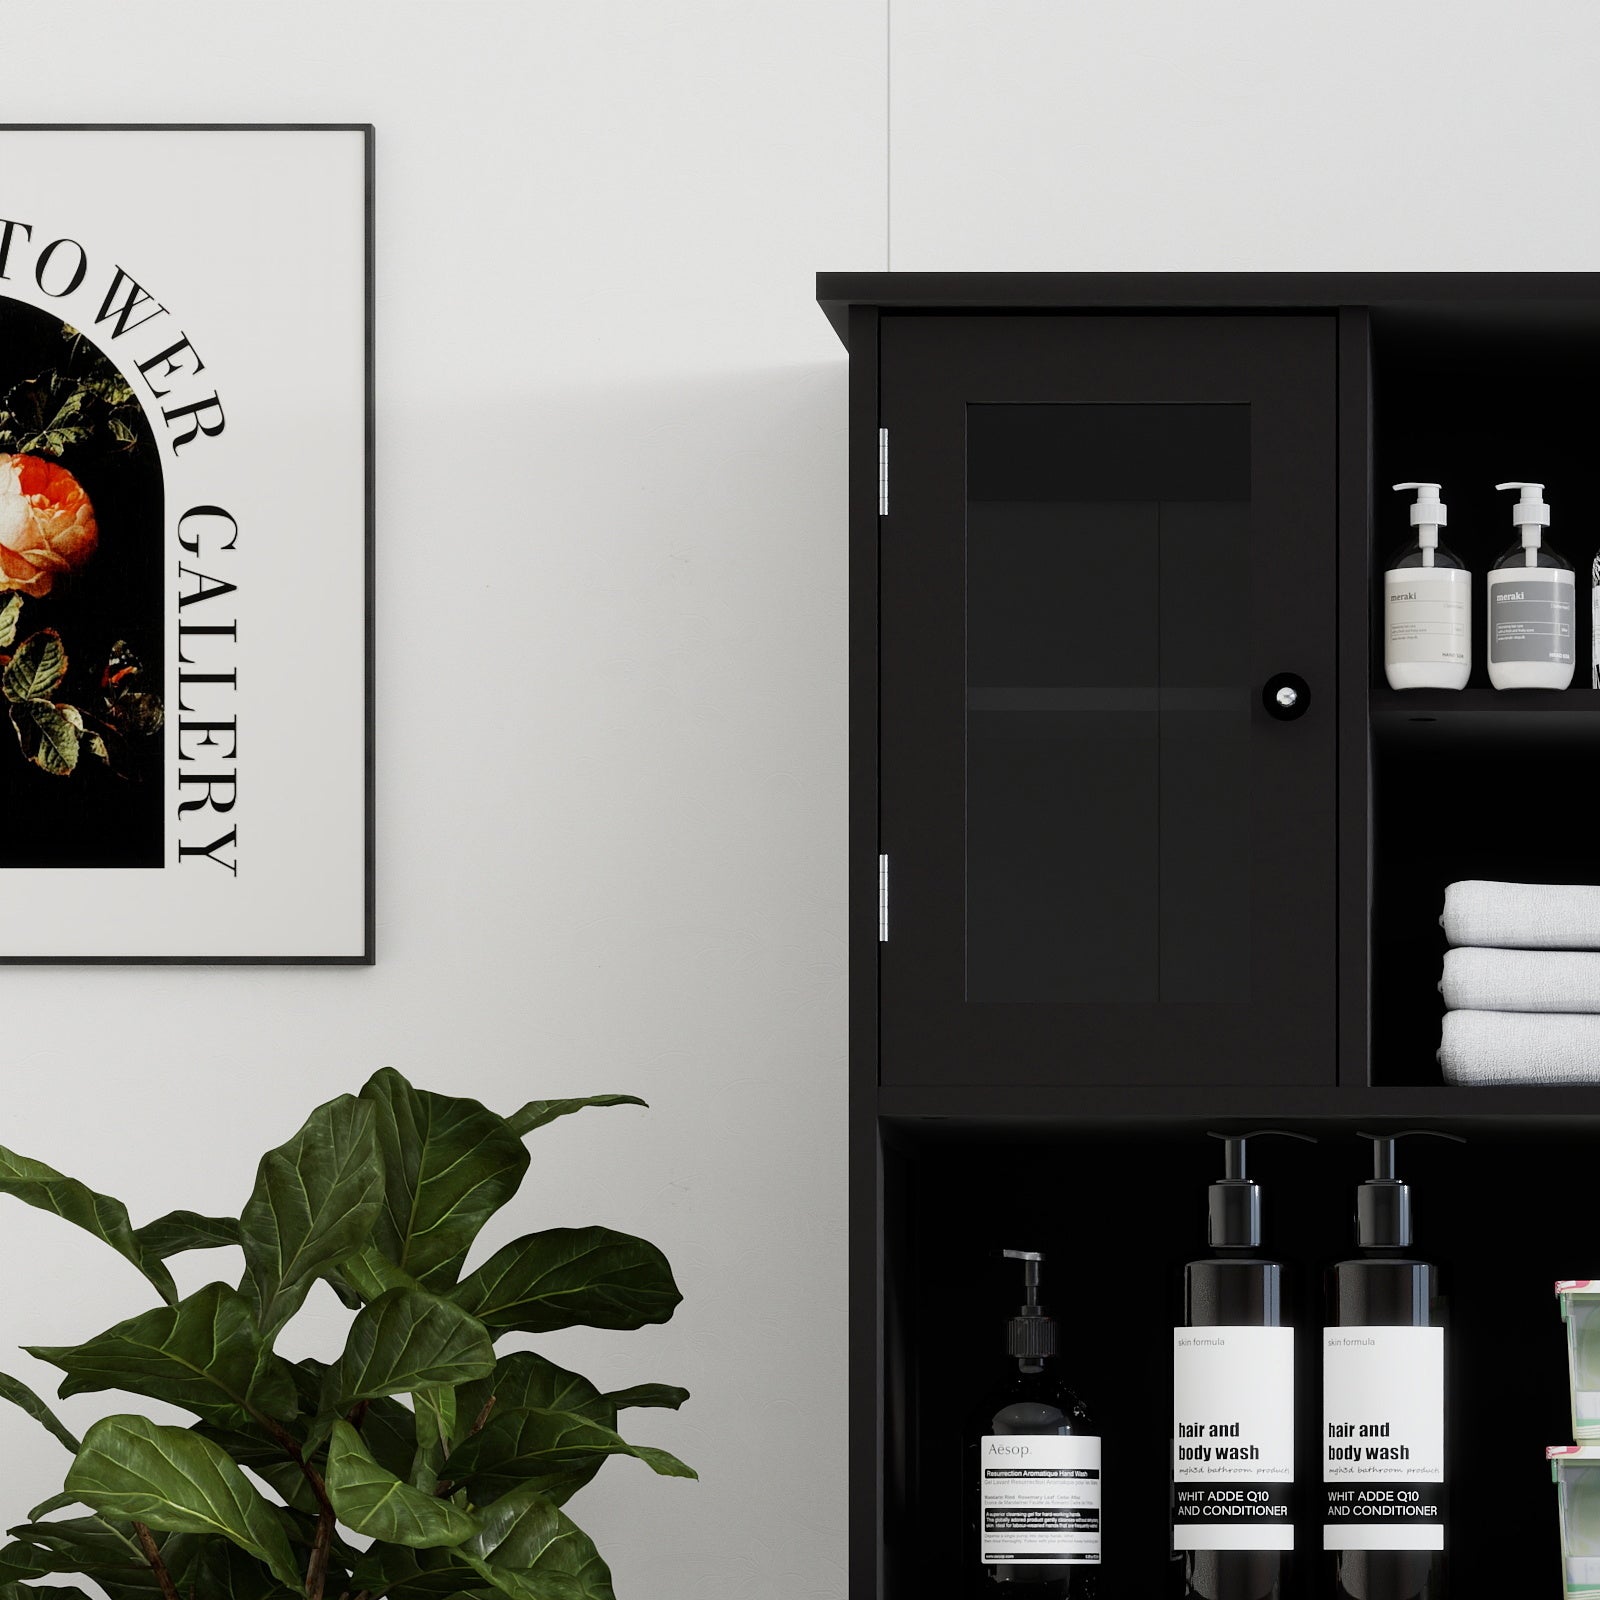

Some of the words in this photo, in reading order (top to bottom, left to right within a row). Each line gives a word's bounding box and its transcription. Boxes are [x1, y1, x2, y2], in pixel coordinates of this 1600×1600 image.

[1390, 592, 1417, 602] meraki
[1496, 591, 1525, 602] meraki
[177, 504, 238, 877] GALLERY
[1178, 1337, 1192, 1347] skin
[1193, 1337, 1225, 1347] formula
[1328, 1337, 1342, 1347] skin
[1343, 1337, 1375, 1347] formula
[1178, 1422, 1205, 1438] hair
[1209, 1422, 1240, 1438] and
[1328, 1422, 1355, 1438] hair
[1359, 1422, 1390, 1438] and
[1178, 1445, 1211, 1462] body
[1215, 1445, 1260, 1461] wash
[1328, 1445, 1361, 1462] body
[1365, 1445, 1410, 1461] wash
[1207, 1466, 1253, 1475] bathroom
[1357, 1466, 1403, 1475] bathroom
[1178, 1491, 1204, 1502] WHIT
[1207, 1491, 1244, 1502] ADDE
[1246, 1491, 1269, 1503] Q10
[1328, 1491, 1354, 1502] WHIT
[1357, 1491, 1394, 1502] ADDE
[1396, 1491, 1419, 1503] Q10
[1178, 1505, 1200, 1516] AND
[1202, 1505, 1288, 1516] CONDITIONER
[1328, 1505, 1350, 1516] AND
[1352, 1505, 1438, 1516] CONDITIONER
